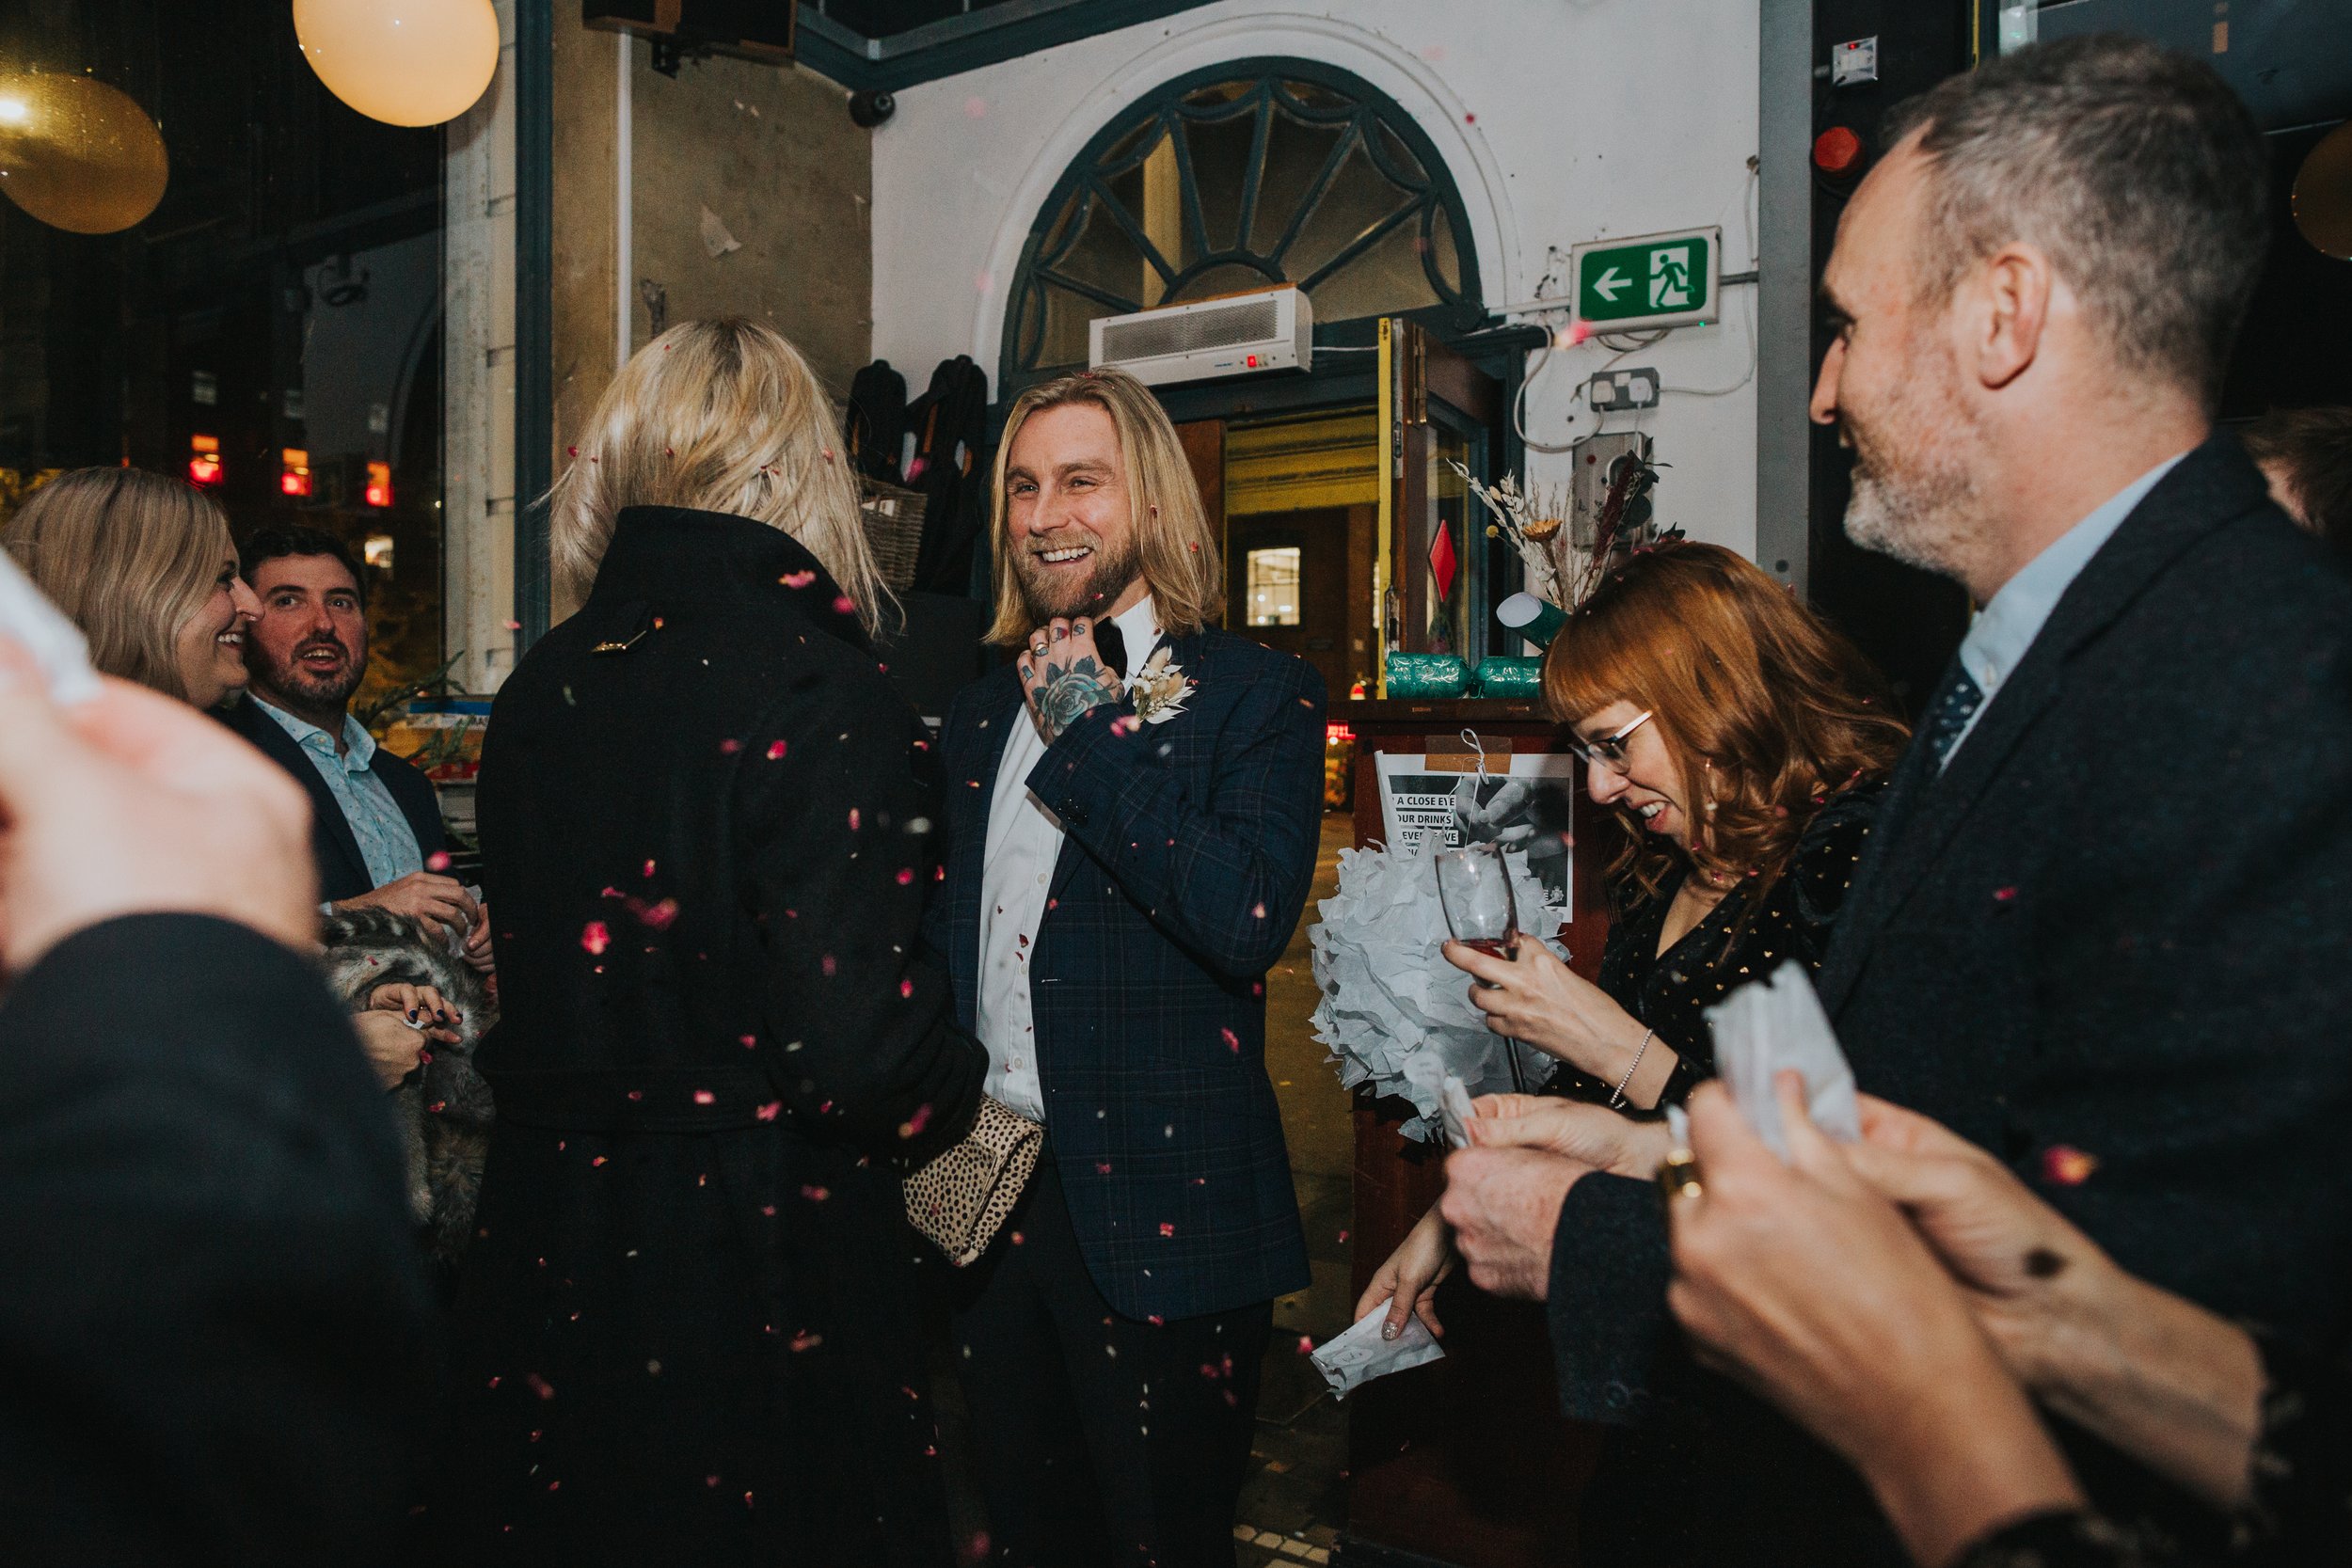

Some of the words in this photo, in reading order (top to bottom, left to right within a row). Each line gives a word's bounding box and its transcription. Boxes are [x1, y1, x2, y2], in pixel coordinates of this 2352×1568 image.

[1397, 797, 1404, 805] A
[1406, 797, 1436, 806] CLOSE
[1417, 815, 1452, 824] DRINKS
[1402, 832, 1422, 841] EVE
